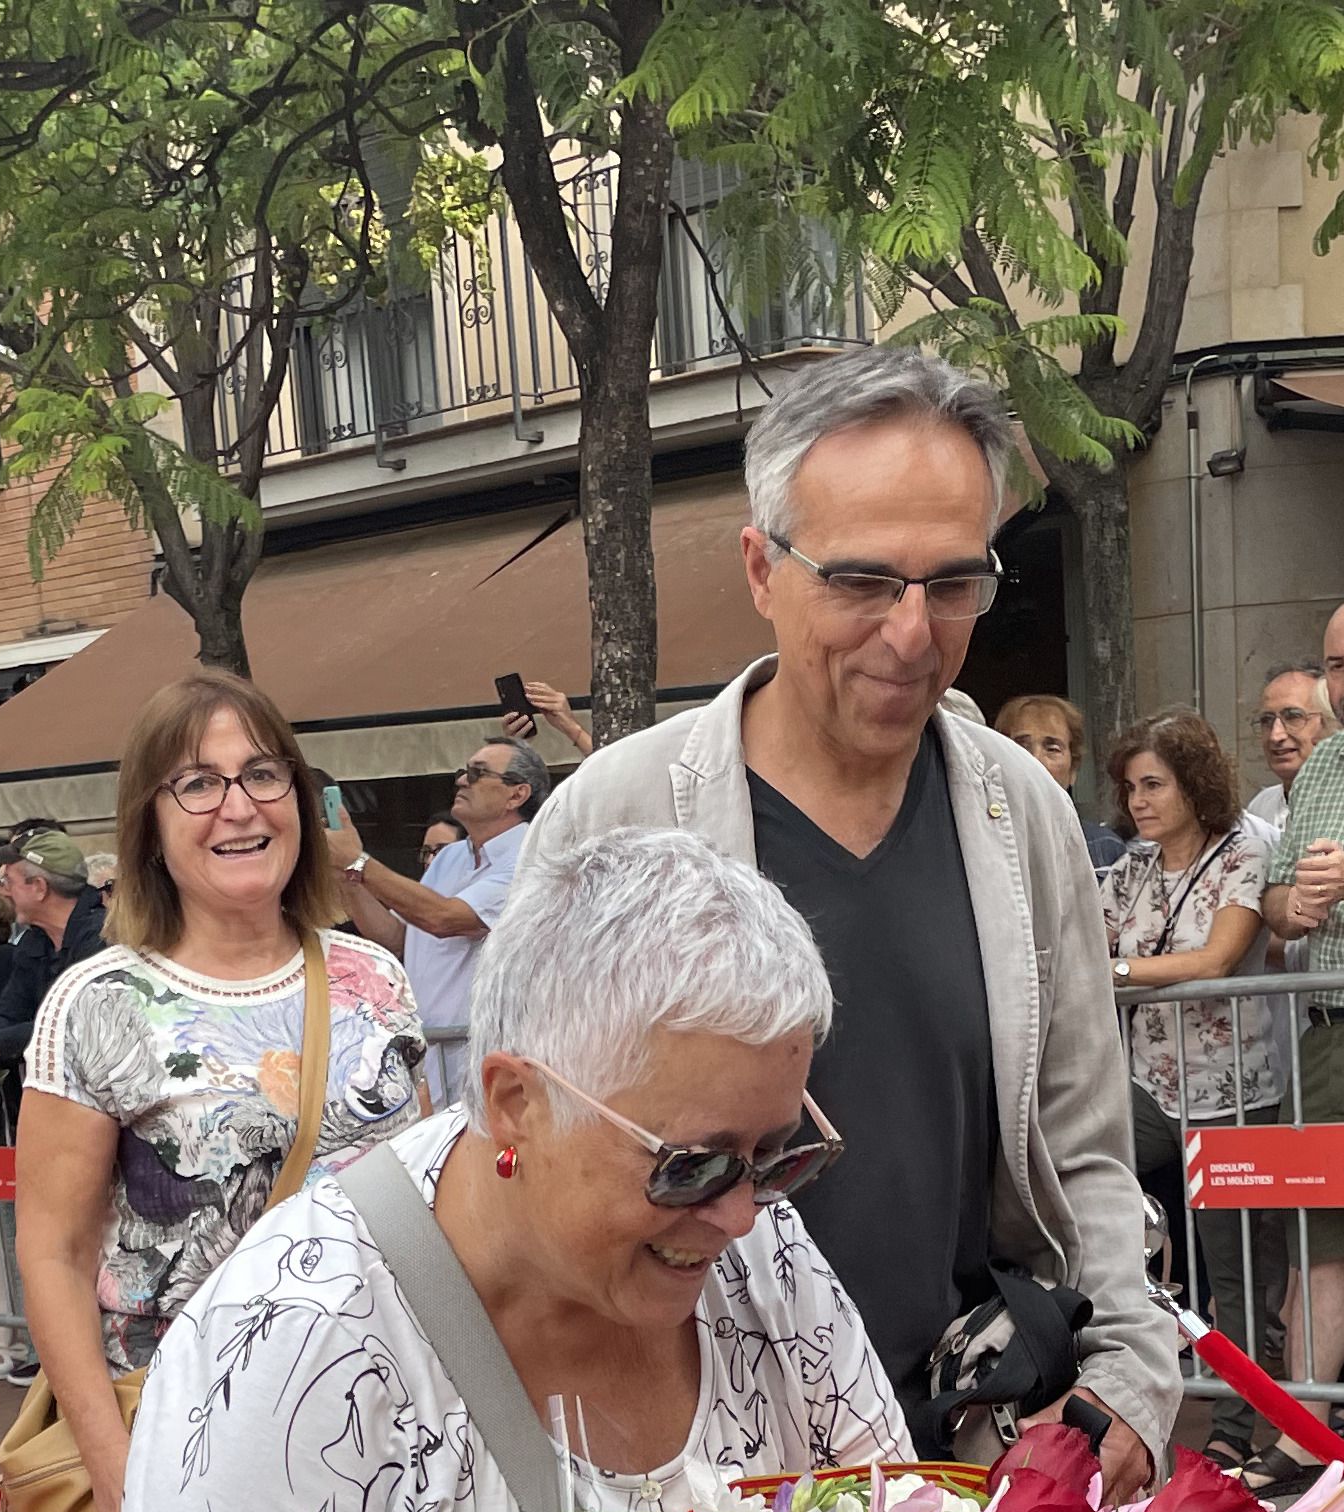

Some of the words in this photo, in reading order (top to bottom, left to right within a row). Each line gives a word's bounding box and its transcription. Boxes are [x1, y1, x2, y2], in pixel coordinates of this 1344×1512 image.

[1209, 1162, 1255, 1173] DISCULPEU
[1210, 1175, 1226, 1186] LES
[1284, 1176, 1326, 1185] www.rubi.cat
